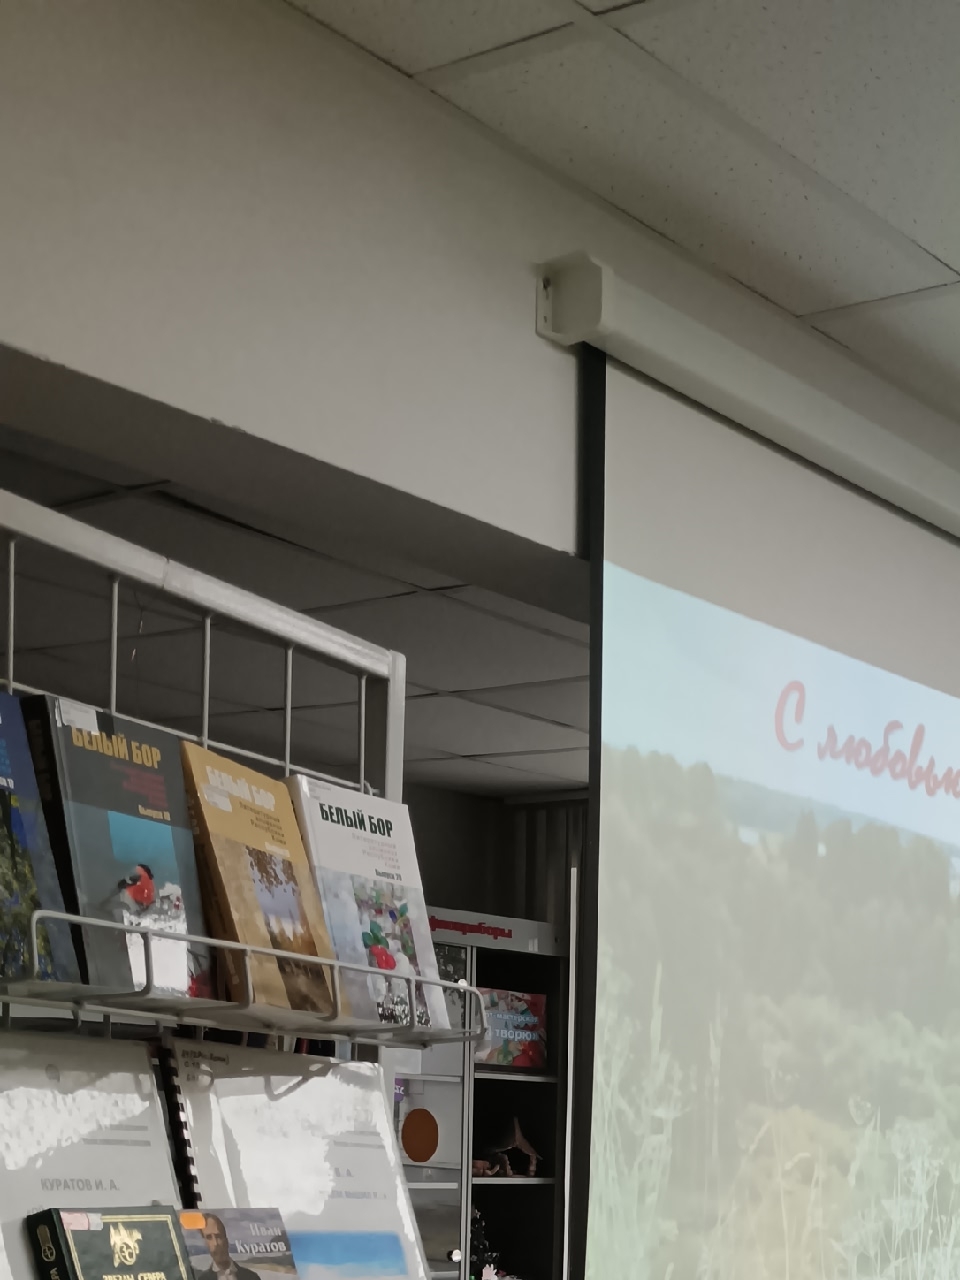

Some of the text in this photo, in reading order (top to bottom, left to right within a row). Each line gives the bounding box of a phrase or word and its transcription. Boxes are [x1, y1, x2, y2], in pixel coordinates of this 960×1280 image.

[774, 679, 806, 752] С
[131, 740, 162, 769] БОР
[319, 802, 393, 838] БЕЛЫЙ БОР
[41, 1178, 93, 1191] КУРАТОВ
[109, 1179, 120, 1191] А.
[249, 1223, 282, 1237] Иван
[234, 1239, 287, 1255] Куратов
